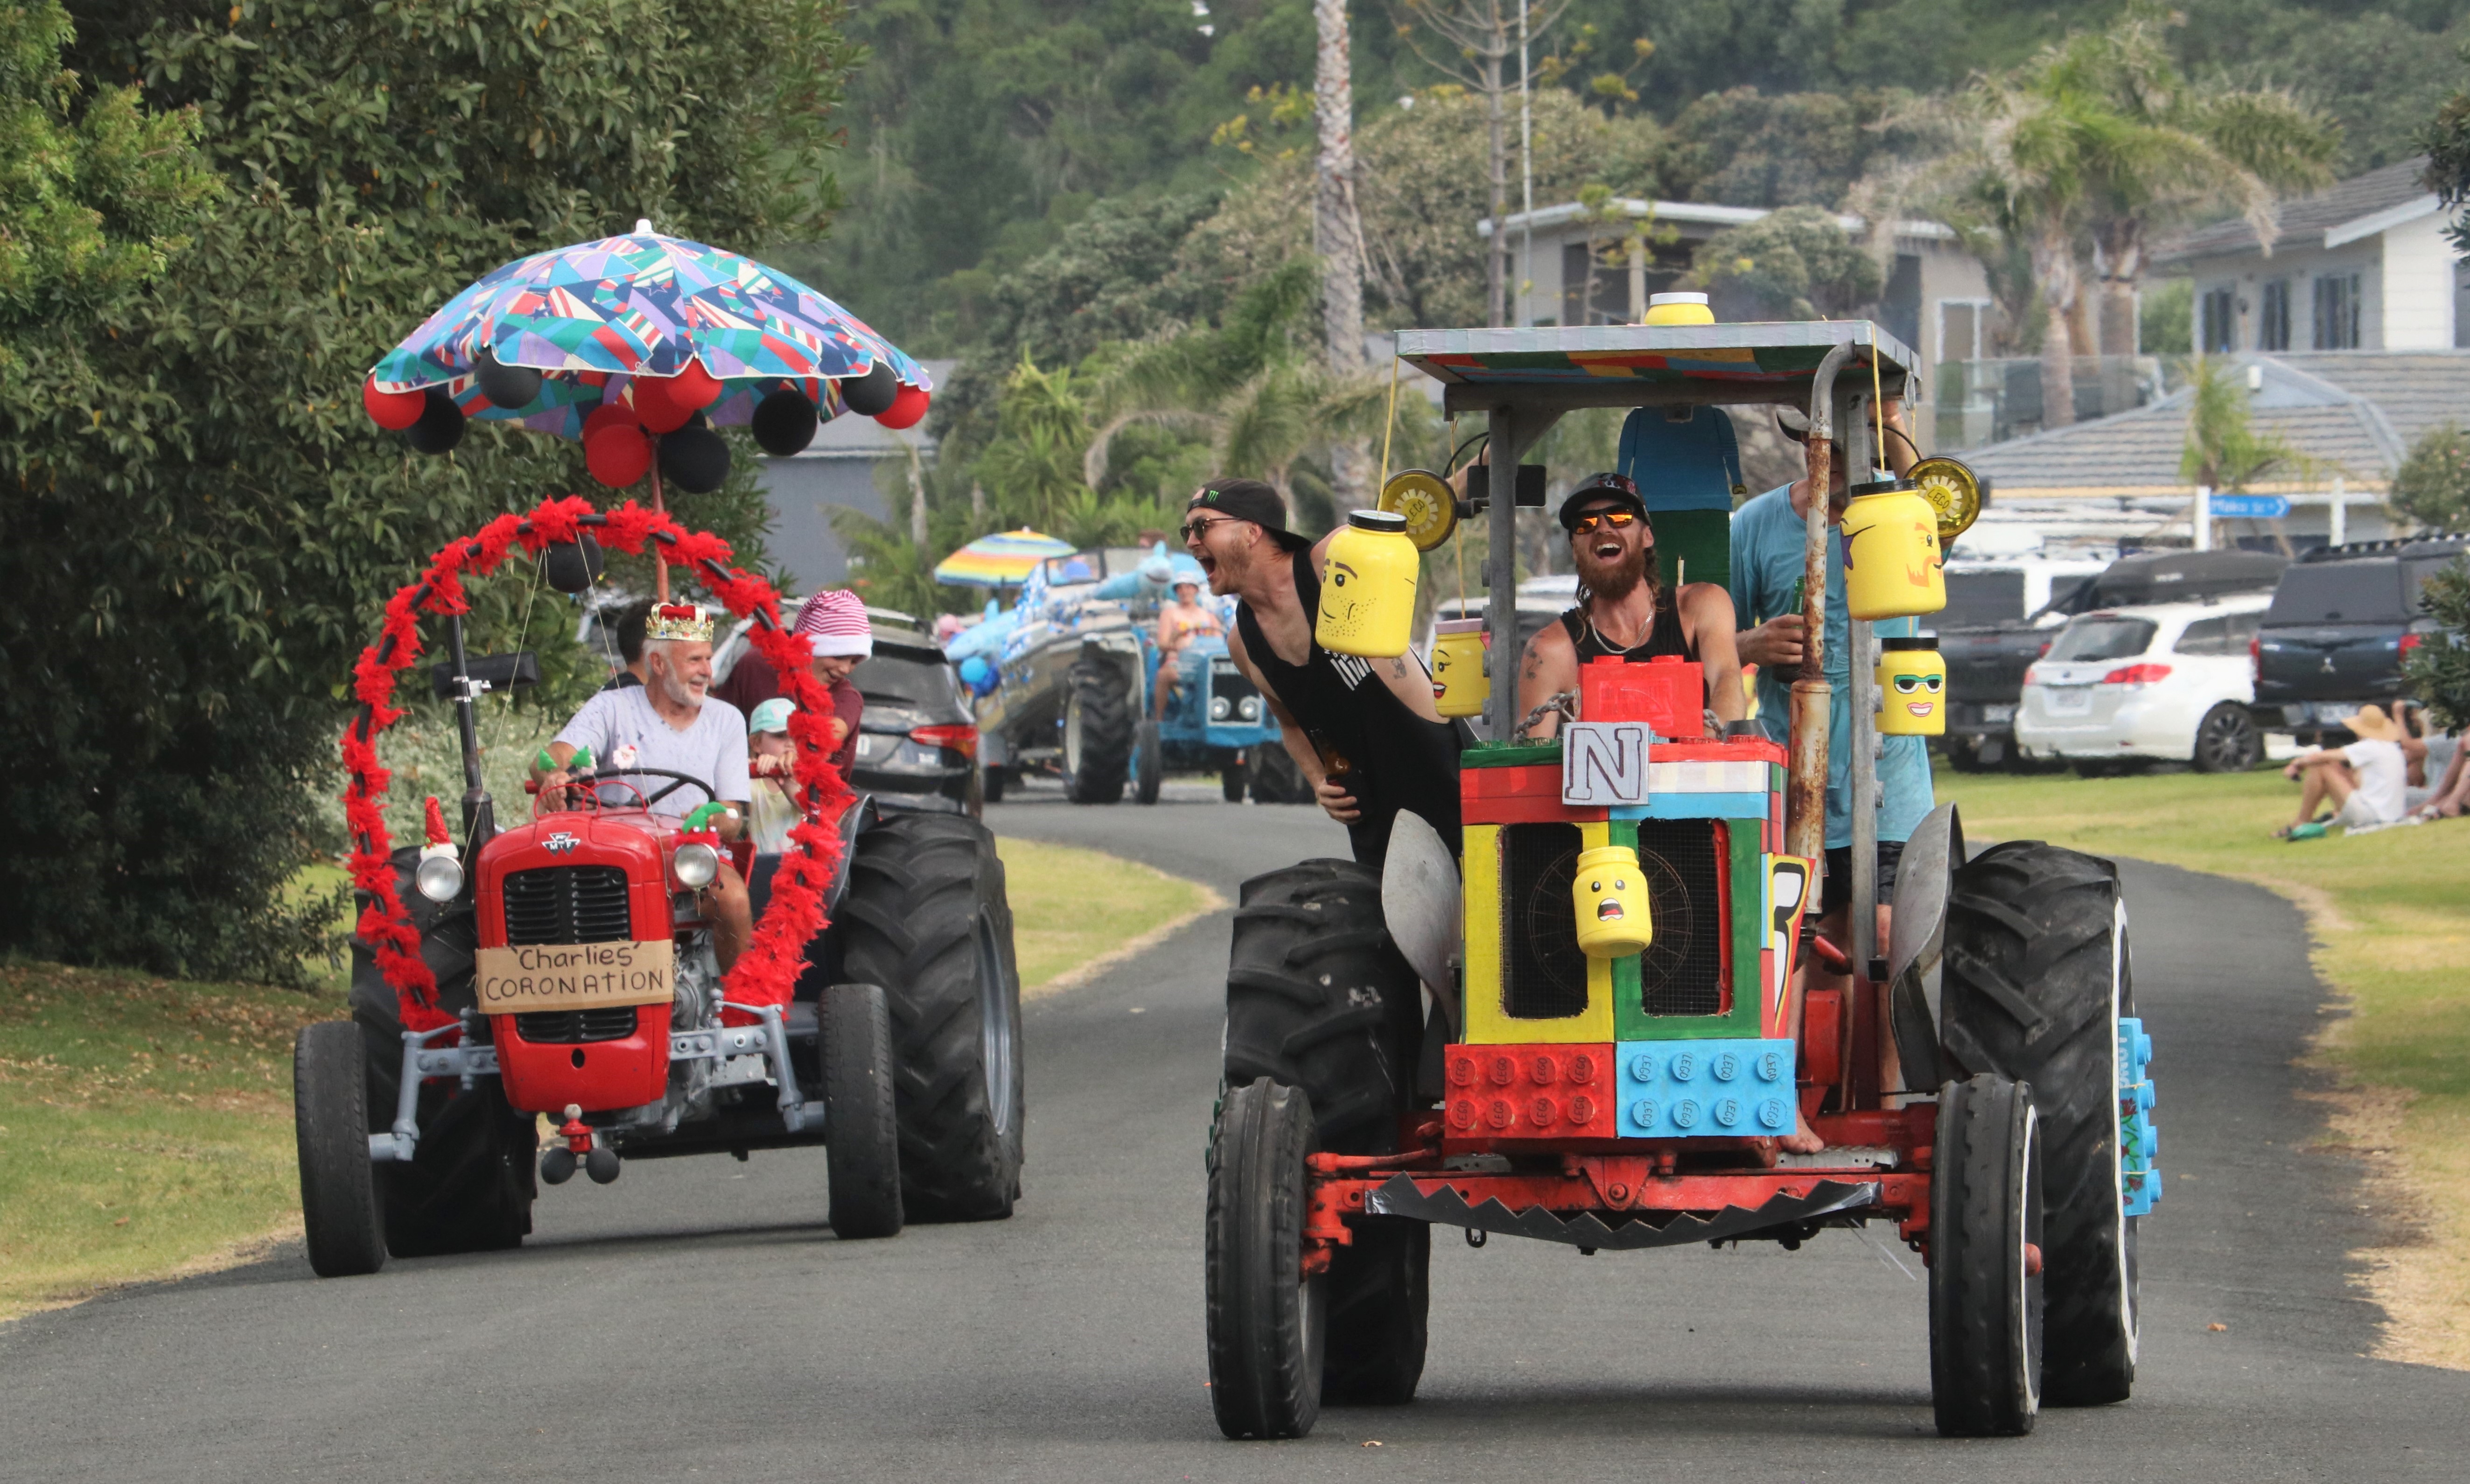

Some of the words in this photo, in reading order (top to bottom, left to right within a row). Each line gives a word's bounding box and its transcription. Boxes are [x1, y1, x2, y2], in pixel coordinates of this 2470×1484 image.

[1405, 499, 1425, 522] LEGO
[1927, 489, 1949, 509] LEGO
[1565, 728, 1642, 800] N
[1456, 1058, 1467, 1082] LEGO
[1497, 1058, 1507, 1083] LEGO
[1537, 1057, 1547, 1082] LEGO
[1575, 1057, 1586, 1081] LEGO
[1639, 1055, 1652, 1080] LEGO
[1679, 1054, 1693, 1079] LEGO
[1721, 1054, 1735, 1079] LEGO
[1766, 1054, 1777, 1079] LEGO
[1457, 1100, 1469, 1126] LEGO
[1494, 1101, 1504, 1125] LEGO
[1537, 1098, 1548, 1124] LEGO
[1574, 1097, 1585, 1121] LEGO
[1642, 1101, 1652, 1126] LEGO
[1680, 1102, 1694, 1125] LEGO
[1723, 1099, 1736, 1123] LEGO
[1767, 1100, 1779, 1125] LEGO
